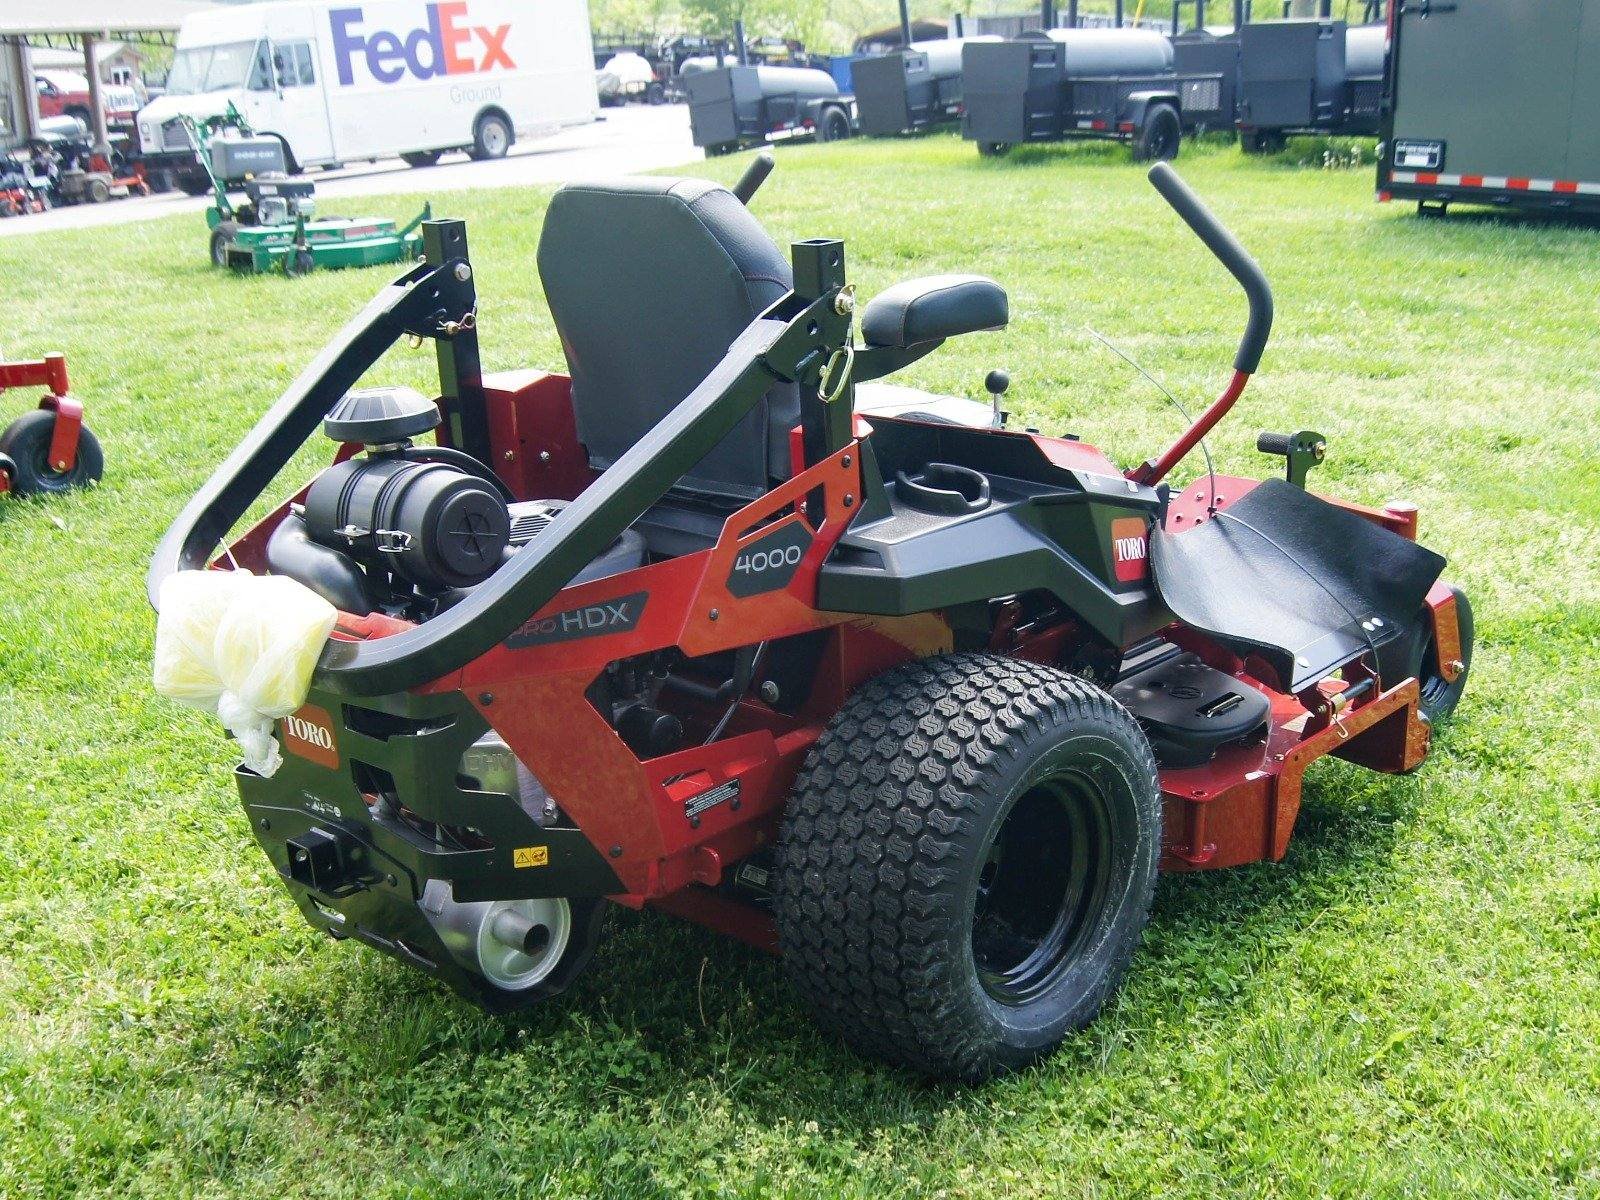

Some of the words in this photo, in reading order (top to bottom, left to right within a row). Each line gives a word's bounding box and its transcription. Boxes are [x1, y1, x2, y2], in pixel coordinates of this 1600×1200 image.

[329, 2, 517, 86] FedEx
[449, 82, 502, 104] Ground
[735, 545, 801, 574] 4000
[1113, 536, 1146, 562] TORO
[561, 602, 630, 633] HDX
[284, 714, 333, 750] TORO
